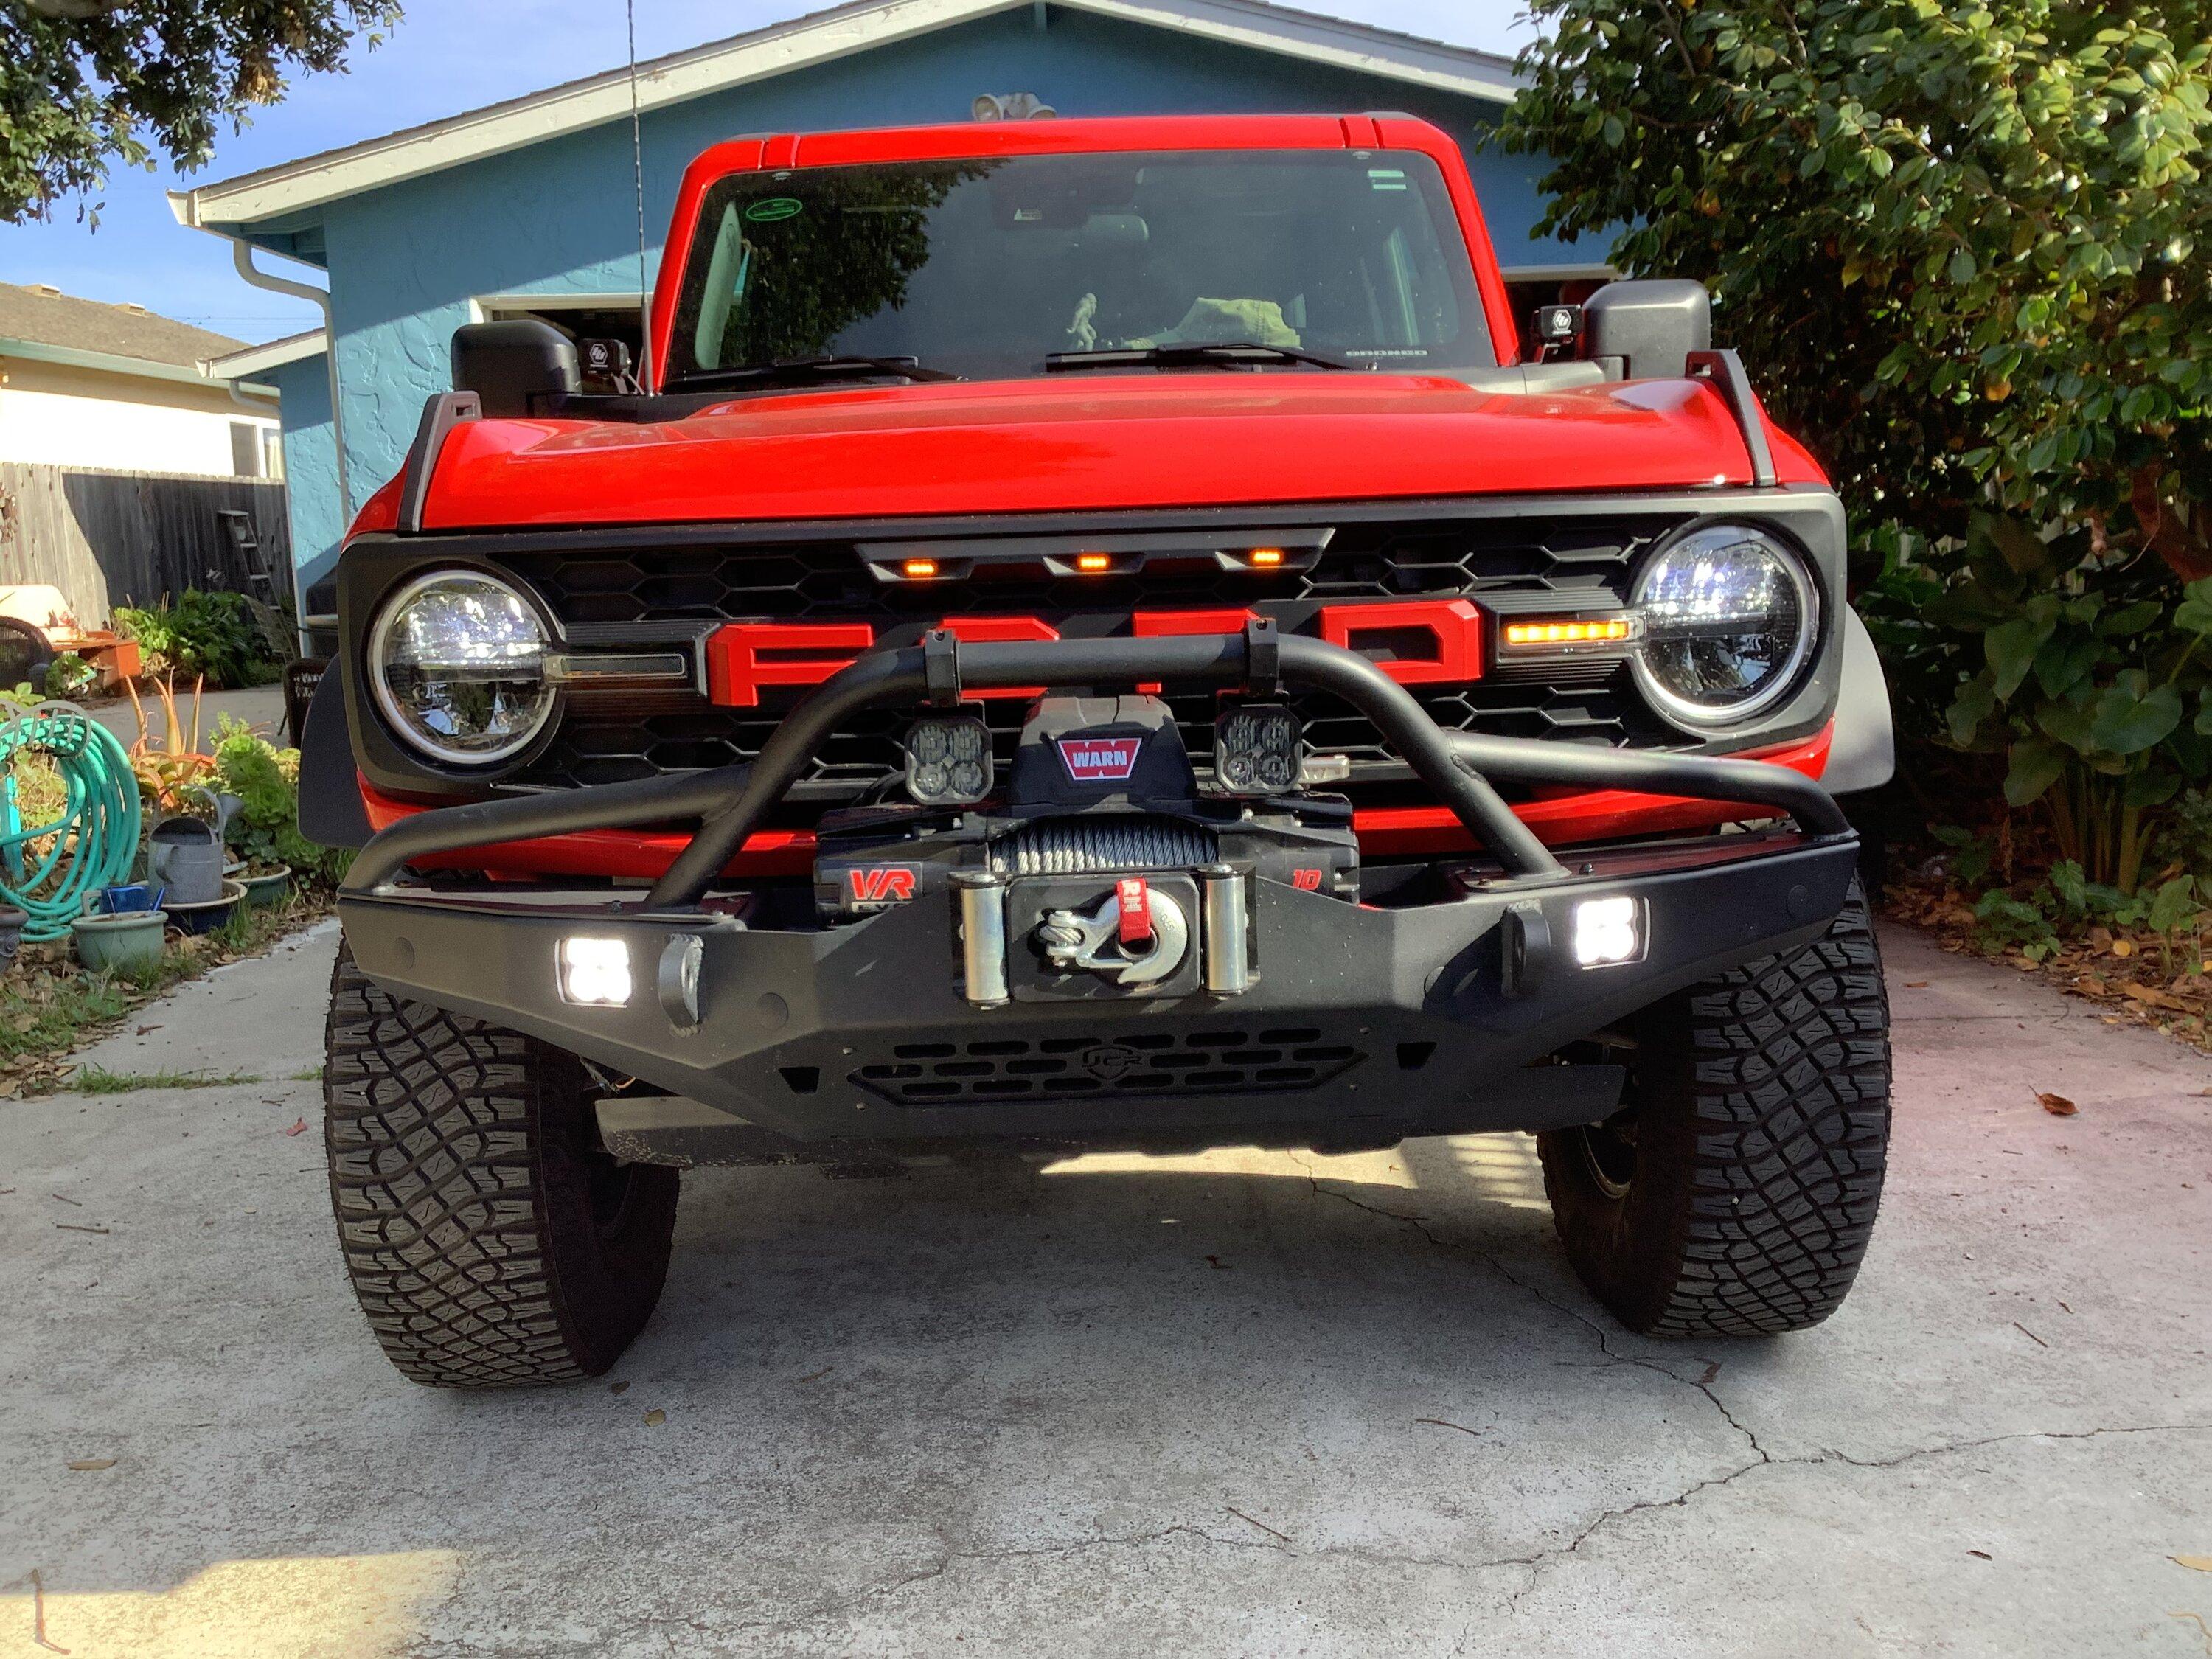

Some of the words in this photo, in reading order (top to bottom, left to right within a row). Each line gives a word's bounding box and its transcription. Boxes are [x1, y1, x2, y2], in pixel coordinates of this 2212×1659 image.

[706, 599, 1481, 706] FD
[1072, 751, 1127, 768] WARN
[849, 869, 916, 900] VR
[1293, 869, 1322, 891] 10
